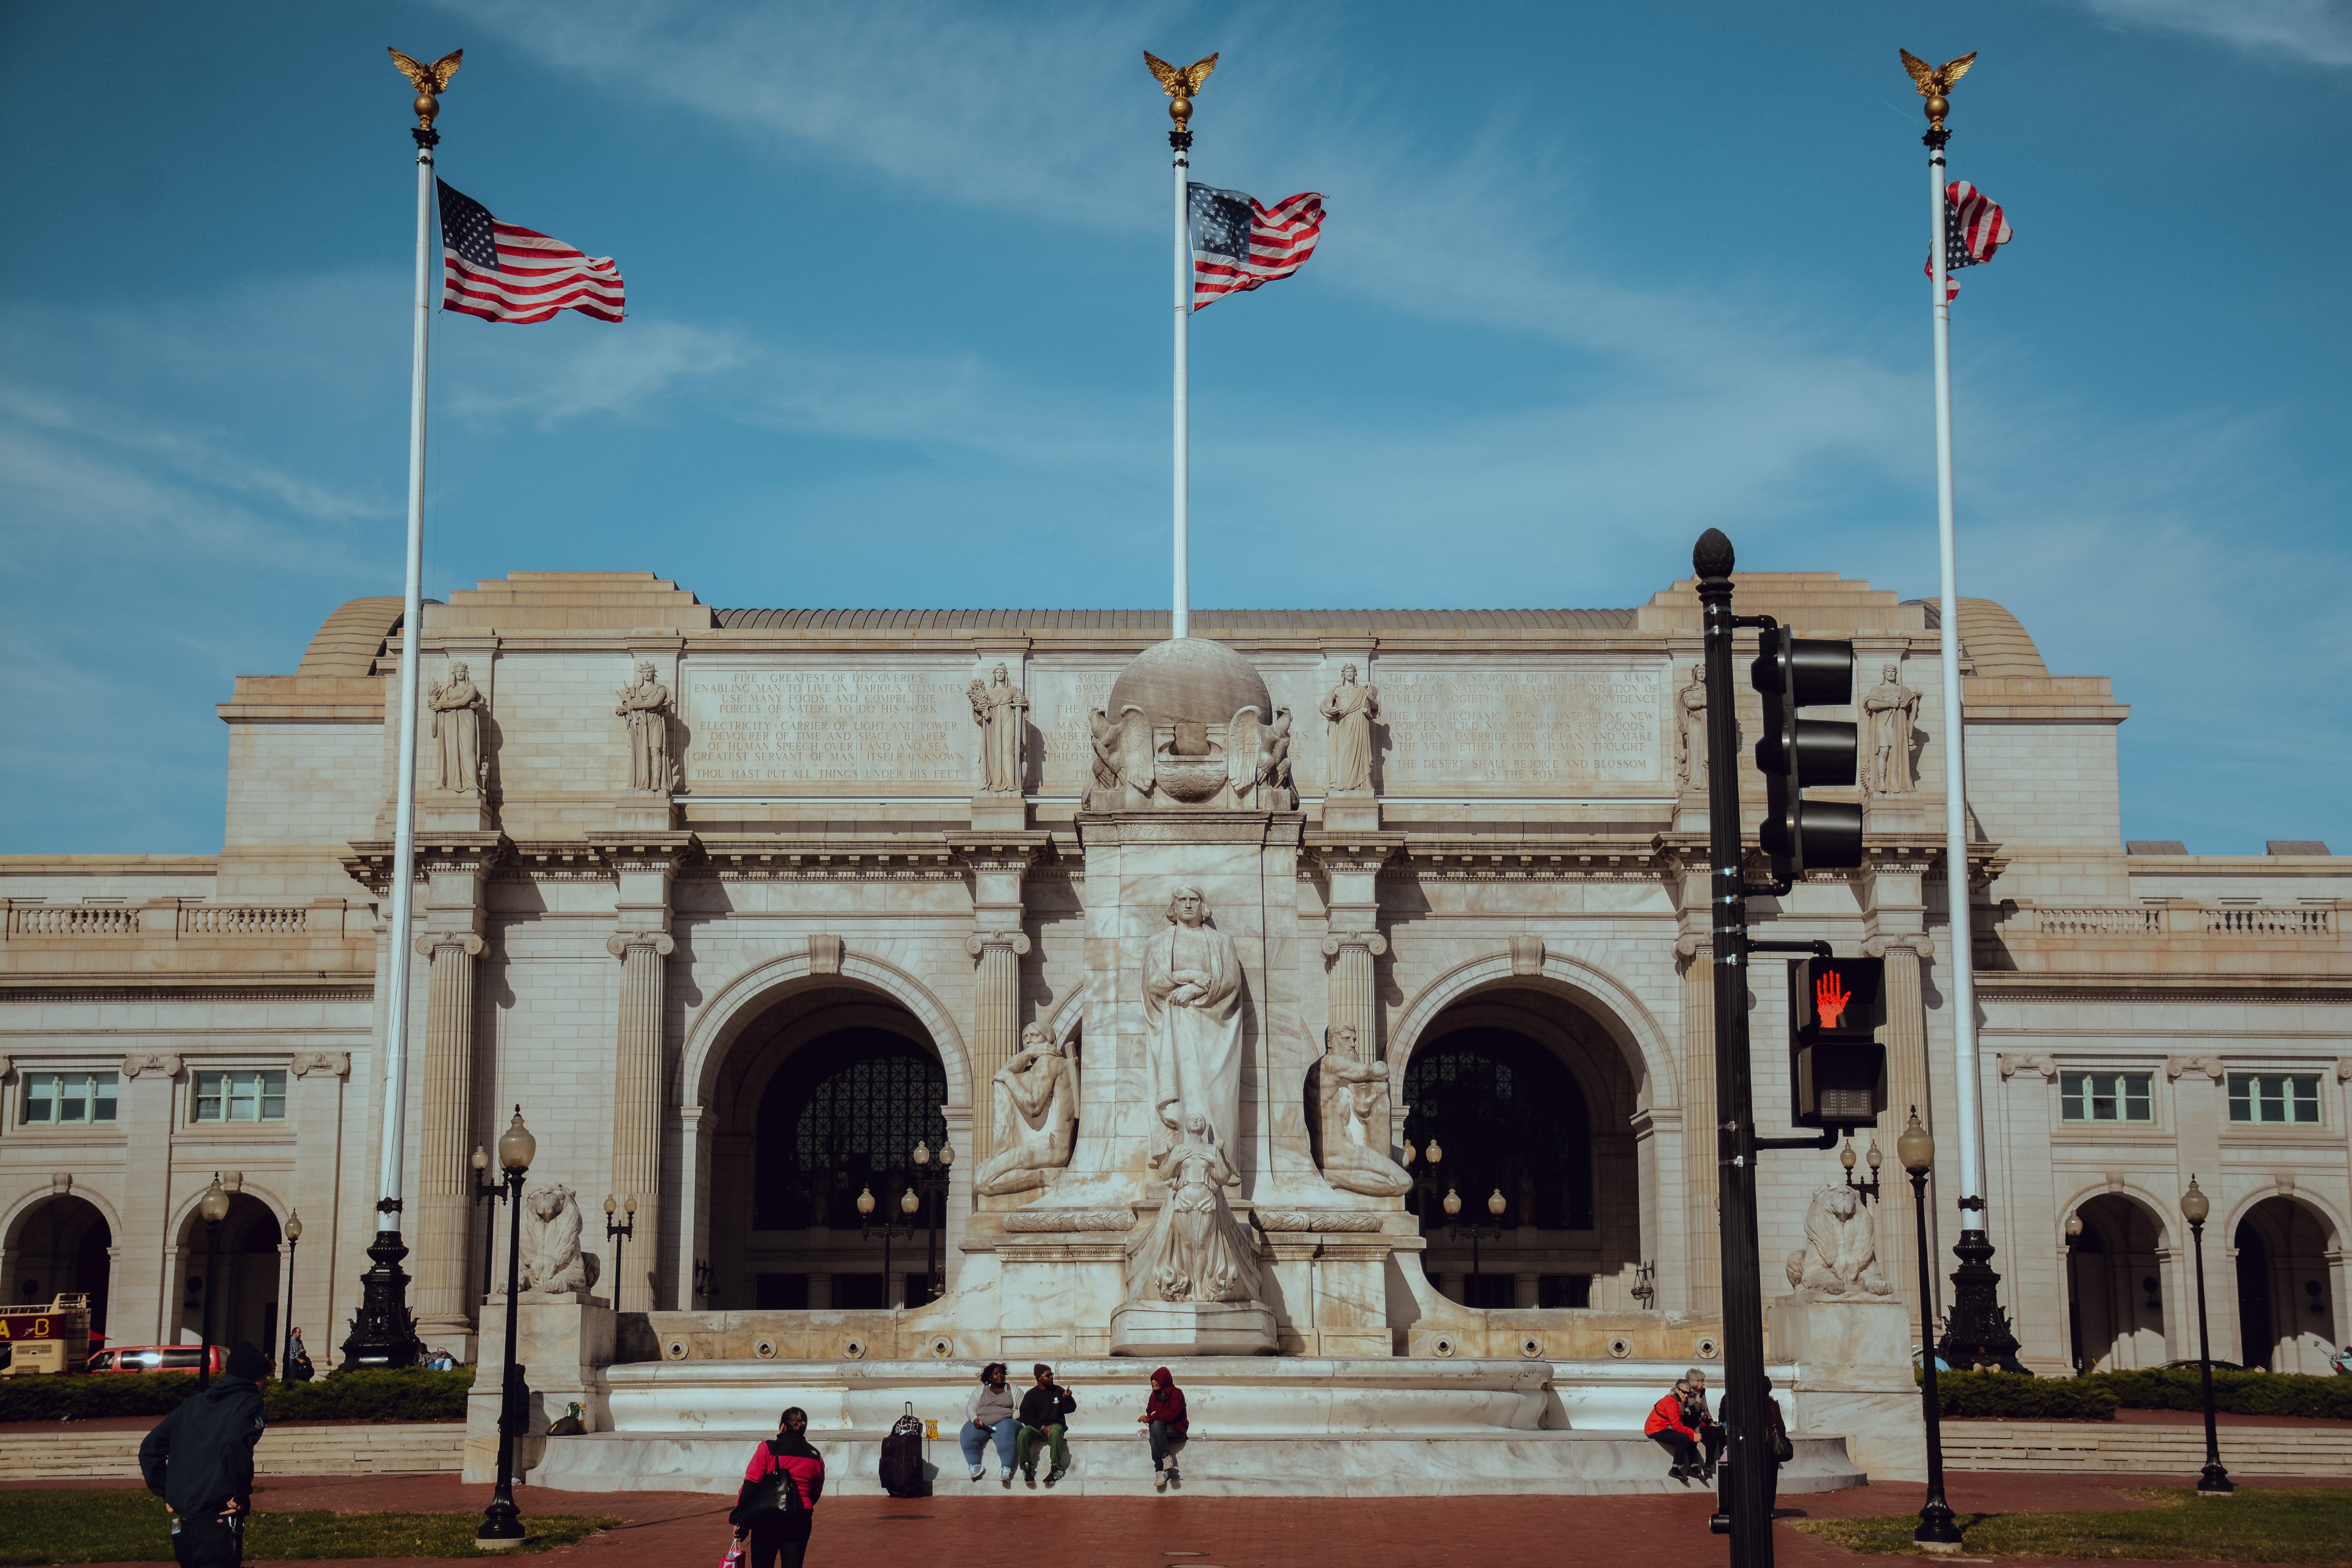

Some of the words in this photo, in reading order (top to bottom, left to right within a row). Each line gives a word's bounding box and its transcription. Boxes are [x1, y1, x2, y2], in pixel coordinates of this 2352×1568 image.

[734, 674, 757, 682] FIRE
[770, 674, 826, 682] GREATEST
[832, 674, 846, 682] OF
[852, 674, 924, 682] DISCOVERIES
[1388, 674, 1408, 682] THE
[1416, 674, 1445, 682] FARM
[1457, 674, 1483, 682] BEST
[1489, 674, 1520, 682] HOME
[1526, 674, 1539, 682] OF
[1547, 674, 1567, 682] THE
[1574, 674, 1612, 682] FAMILY
[1624, 674, 1652, 682] MAIN
[695, 684, 750, 693] ENABLING
[756, 684, 781, 693] MAN
[787, 684, 801, 693] TO
[808, 684, 831, 693] LIVE
[837, 684, 848, 693] IN
[856, 684, 902, 693] VARIOUS
[908, 684, 963, 693] CLIMATES
[1383, 684, 1424, 693] SOURCE
[1432, 684, 1446, 693] OF
[1452, 684, 1505, 693] NATIONAL
[1512, 684, 1557, 693] WEALTH
[1570, 684, 1638, 693] FOUNDATION
[1644, 684, 1658, 693] OF
[722, 694, 743, 702] USE
[750, 694, 782, 702] MANY
[789, 694, 825, 702] FOODS
[834, 694, 858, 702] AND
[865, 694, 909, 702] COMPEL
[915, 694, 936, 702] THE
[1384, 695, 1438, 703] CIVILIZED
[1446, 695, 1491, 703] SOCIETY
[1504, 695, 1524, 703] THE
[1532, 695, 1582, 703] NATURAL
[1589, 695, 1657, 703] PROVIDENCE
[719, 704, 761, 713] FORCES
[768, 704, 782, 713] OF
[788, 704, 831, 713] NATURE
[838, 704, 852, 713] TO
[859, 704, 875, 713] DO
[882, 704, 899, 713] HIS
[906, 704, 938, 713] WORK
[1055, 705, 1079, 713] THE
[1388, 711, 1408, 720] THE
[1416, 711, 1437, 720] OLD
[1444, 711, 1502, 720] MECHANIC
[1510, 711, 1535, 720] ARTS
[1547, 711, 1623, 720] CONTROLLING
[1630, 711, 1654, 720] NEW
[700, 721, 771, 730] ELECTRICITY
[781, 721, 828, 730] CARRIER
[834, 721, 847, 730] OF
[853, 721, 885, 730] LIGHT
[891, 721, 914, 730] AND
[921, 721, 957, 730] POWER
[1056, 721, 1089, 730] MAN'S
[1395, 722, 1437, 730] FORCES
[1447, 722, 1479, 730] BUILD
[1486, 722, 1508, 730] NEW
[1517, 722, 1571, 730] HIGHWAYS
[1579, 722, 1598, 730] FOR
[1607, 722, 1644, 730] GOODS
[711, 732, 769, 740] DEVOURER
[776, 732, 789, 740] OF
[795, 732, 821, 740] TIME
[827, 732, 851, 740] AND
[858, 732, 891, 740] SPACE
[904, 732, 946, 740] BEARER
[1420, 732, 1443, 741] MEN
[1455, 732, 1508, 741] OVERRIDE
[1517, 732, 1536, 741] THE
[1543, 732, 1581, 741] OCEAN
[1591, 732, 1615, 741] AND
[1621, 732, 1653, 741] MAKE
[708, 742, 722, 751] OF
[728, 742, 769, 751] HUMAN
[776, 742, 818, 751] SPEECH
[824, 742, 853, 751] OVER
[860, 742, 891, 751] LAND
[897, 742, 921, 751] AND
[928, 742, 949, 751] SEA
[1045, 742, 1069, 751] AND
[1397, 742, 1418, 751] THE
[1424, 742, 1452, 751] VERY
[1460, 742, 1494, 751] ETHER
[1501, 742, 1537, 751] CARRY
[1544, 742, 1585, 751] HUMAN
[1592, 742, 1644, 751] THOUGHT
[693, 752, 749, 761] GREATEST
[755, 752, 803, 761] SERVANT
[810, 752, 824, 761] OF
[830, 752, 855, 761] MAN
[867, 752, 904, 761] ITSELF
[908, 752, 964, 761] UNKNOWN
[1396, 760, 1417, 768] THE
[1424, 760, 1465, 768] DESERT
[1473, 760, 1507, 768] SHALL
[1514, 760, 1559, 768] REJOICE
[1565, 760, 1588, 768] AND
[1594, 760, 1646, 768] BLOSSOM
[696, 769, 724, 778] THOU
[732, 769, 761, 778] HAST
[767, 769, 789, 778] PUT
[791, 769, 812, 778] ALL
[818, 769, 858, 778] THINGS
[866, 769, 902, 778] UNDER
[910, 769, 927, 778] HIS
[935, 769, 960, 778] FEET
[1482, 770, 1496, 779] AS
[1504, 770, 1524, 779] THE
[1532, 770, 1559, 779] ROSE
